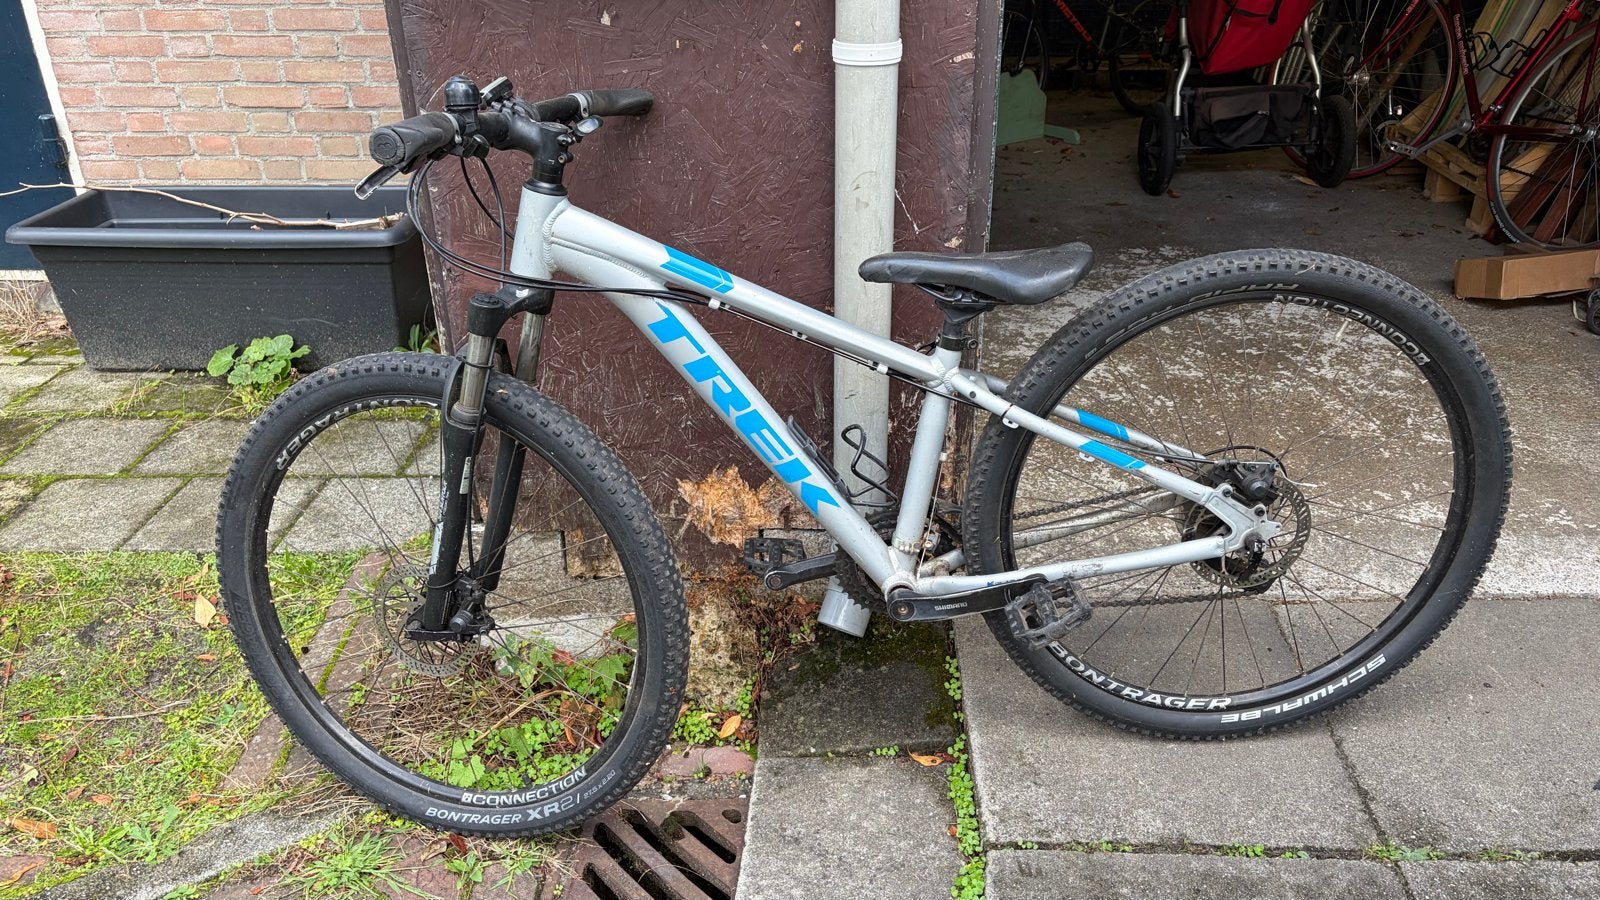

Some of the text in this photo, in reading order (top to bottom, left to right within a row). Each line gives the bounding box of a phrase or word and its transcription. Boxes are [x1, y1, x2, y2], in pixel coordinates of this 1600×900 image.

[1274, 294, 1425, 356] CONNECTION
[648, 301, 840, 516] TREK
[934, 601, 967, 611] SHIMANO
[1049, 640, 1231, 709] BONTRAGER
[1221, 653, 1386, 723] SCHWALBE
[425, 807, 522, 824] BONTRAGER
[473, 765, 587, 806] CONNECTION
